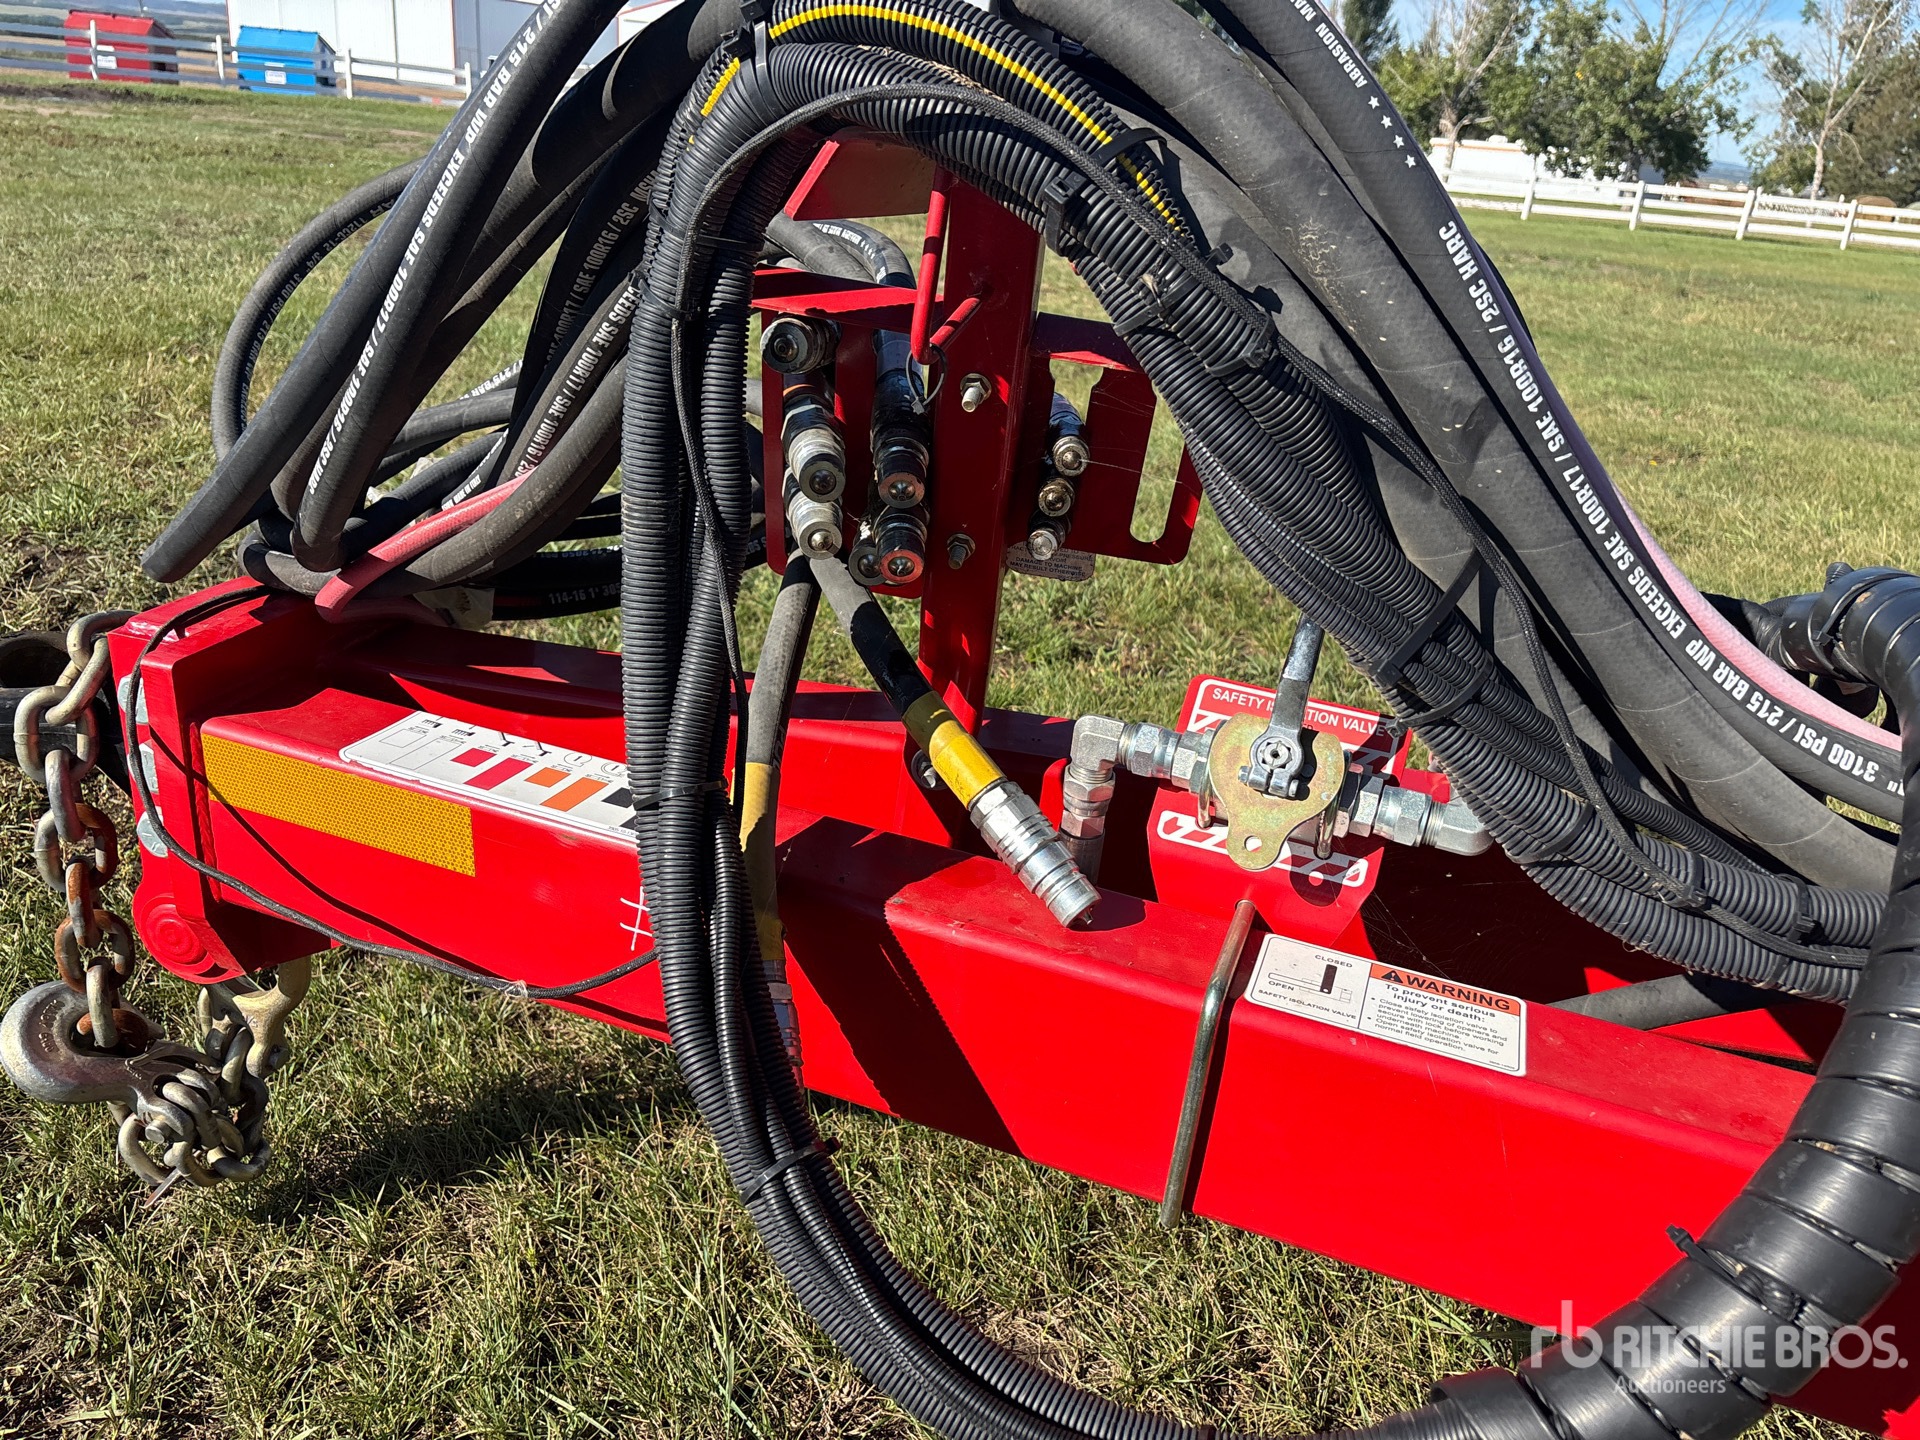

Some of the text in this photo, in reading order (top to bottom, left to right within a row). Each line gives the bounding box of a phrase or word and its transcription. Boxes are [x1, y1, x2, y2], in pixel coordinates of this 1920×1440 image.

[1290, 0, 1316, 22] MA
[509, 26, 537, 67] 215
[1315, 22, 1368, 89] ABRASION
[484, 68, 512, 109] BAR
[466, 108, 488, 144] WP
[422, 148, 464, 228] EXCEEDS
[612, 202, 640, 226] 2SC
[404, 227, 426, 266] SAE
[583, 230, 618, 270] 100R16
[1438, 220, 1478, 281] HARC
[376, 267, 408, 333] 100R17
[573, 272, 596, 294] SAE
[1468, 278, 1500, 322] 2SC
[592, 322, 619, 348] SAE
[357, 340, 375, 376] SAE
[566, 346, 604, 392] 100R17
[1498, 334, 1544, 412] 100R16
[333, 374, 360, 432] 100R16
[548, 395, 572, 420] SAE
[528, 418, 556, 456] 100R16
[1536, 411, 1564, 452] SAE
[1562, 466, 1611, 534] 100R17
[1604, 531, 1634, 570] SAE
[1628, 566, 1687, 639] EXCEEDS
[1686, 638, 1716, 671] WP
[1712, 665, 1750, 701] BAR
[1212, 688, 1265, 709] SAFETY
[1342, 717, 1386, 736] VALVE
[1746, 693, 1784, 726] 215
[1793, 724, 1828, 755] PSI
[1828, 744, 1880, 782] 3100
[1315, 955, 1353, 968] CLOSED
[1258, 989, 1356, 1019] SAFETY ISOLATION VALVE
[1268, 981, 1294, 991] OPEN
[1403, 989, 1448, 1005] prevent
[1451, 1002, 1496, 1018] serious
[1406, 975, 1510, 1010] WARNING
[1376, 1014, 1422, 1029] underneath
[1378, 1004, 1408, 1015] prevent
[1411, 1011, 1444, 1026] lowering
[1380, 999, 1402, 1008] Close
[1404, 1004, 1428, 1016] safety
[1431, 1010, 1464, 1024] isolation
[1466, 1021, 1488, 1031] valve
[1394, 994, 1427, 1007] injury
[1447, 1008, 1485, 1022] death:
[1375, 1023, 1403, 1034] normal
[1405, 1030, 1422, 1040] field
[1376, 1018, 1398, 1027] Open
[1400, 1025, 1425, 1036] safety
[1427, 1030, 1461, 1044] isolation
[1464, 1041, 1485, 1051] valve
[1378, 1009, 1504, 1047] secure with lock before working
